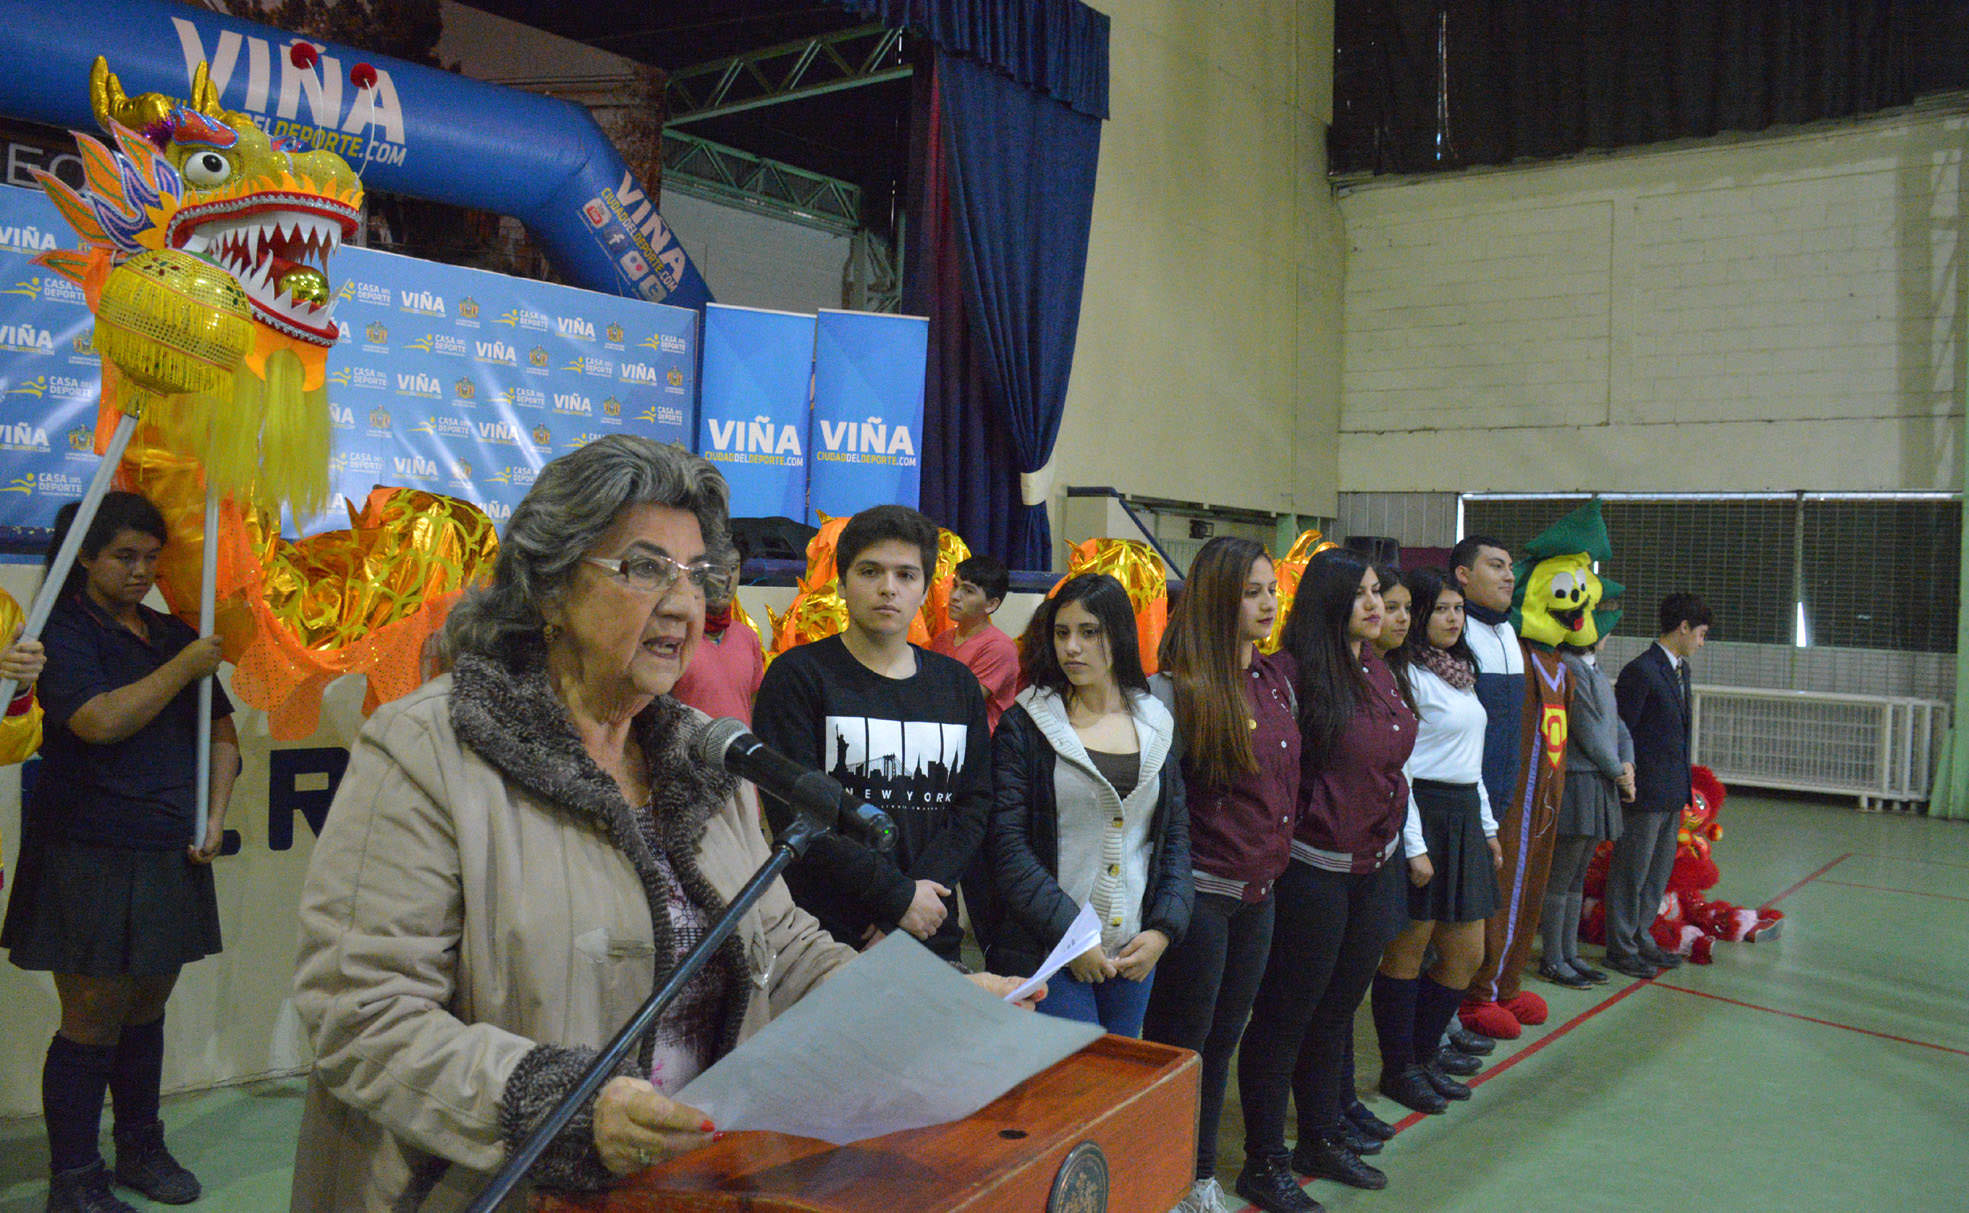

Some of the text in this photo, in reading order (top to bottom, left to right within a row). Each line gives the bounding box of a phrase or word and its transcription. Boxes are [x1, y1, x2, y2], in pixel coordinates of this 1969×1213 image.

[170, 17, 406, 145] VIÑA
[616, 169, 686, 284] VIÑA
[44, 287, 87, 301] DEPORT
[358, 282, 380, 293] CASA
[401, 290, 445, 313] VIÑA
[557, 316, 596, 337] VIÑA
[475, 340, 517, 362] VIÑA
[49, 375, 79, 388] CASA
[621, 362, 657, 381] VIÑA
[397, 373, 441, 394] VIÑA
[553, 392, 592, 412] VIÑA
[0, 422, 50, 446] IÑA
[708, 415, 802, 456] VIÑA
[819, 416, 915, 456] VIÑA
[393, 456, 438, 476] VIÑA
[704, 451, 804, 467] CIUDADDELDEPORTE.COM
[817, 450, 917, 467] CIUDADDELDEPORTE.COM
[483, 500, 511, 519] IÑA
[906, 790, 953, 803] YORK
